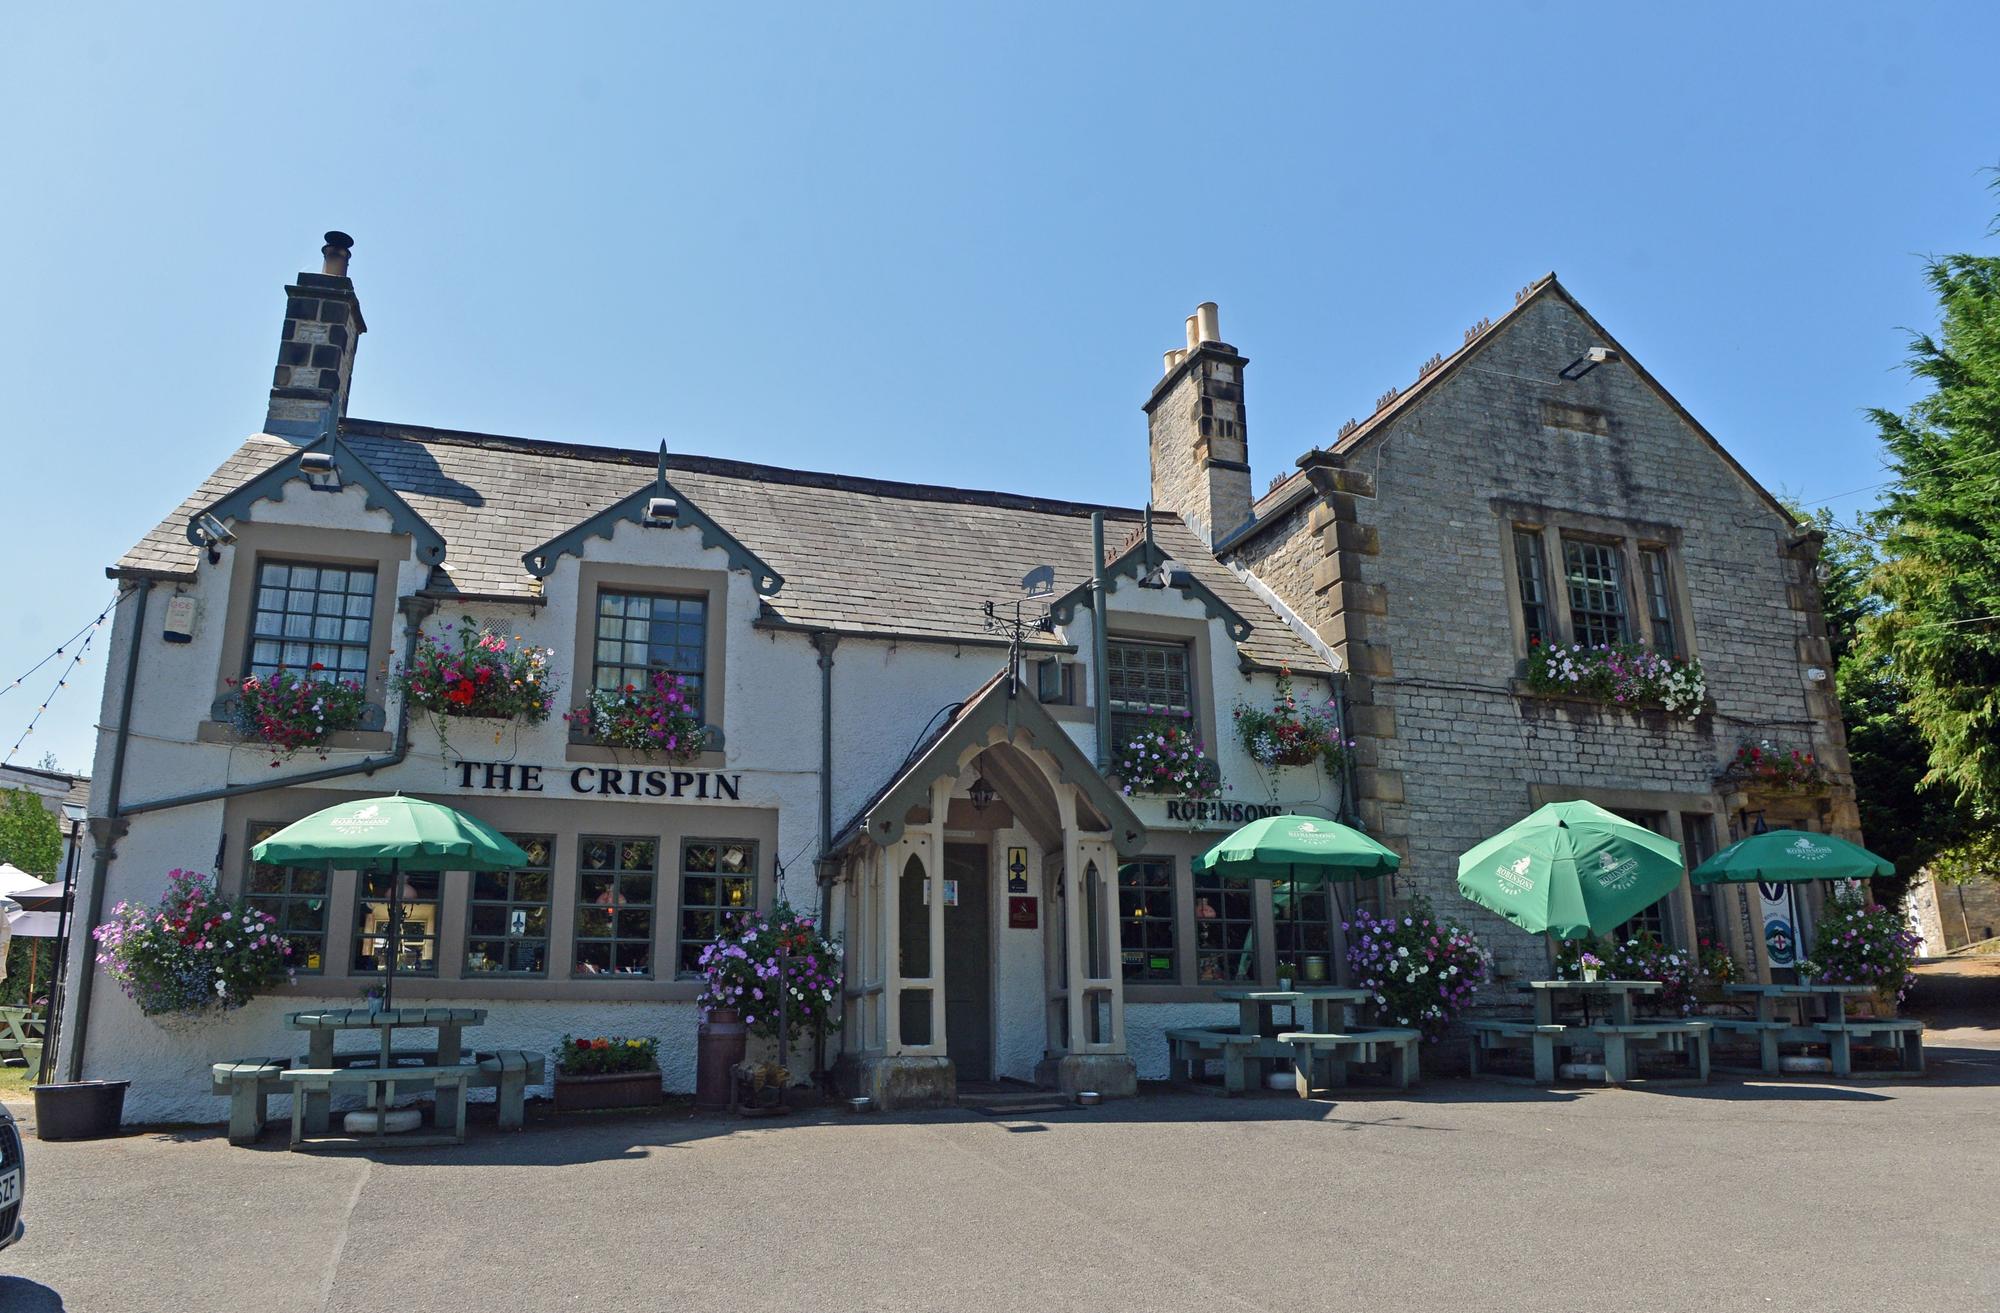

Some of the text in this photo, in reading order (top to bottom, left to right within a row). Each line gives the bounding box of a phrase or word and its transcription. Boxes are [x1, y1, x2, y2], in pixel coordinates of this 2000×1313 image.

[455, 760, 741, 800] THE CRISPIN
[1167, 800, 1282, 822] ROBINSONS
[1496, 866, 1533, 890] ROBINSONS
[1598, 859, 1638, 887] ROBINSONS
[0, 1175, 15, 1204] ZF
